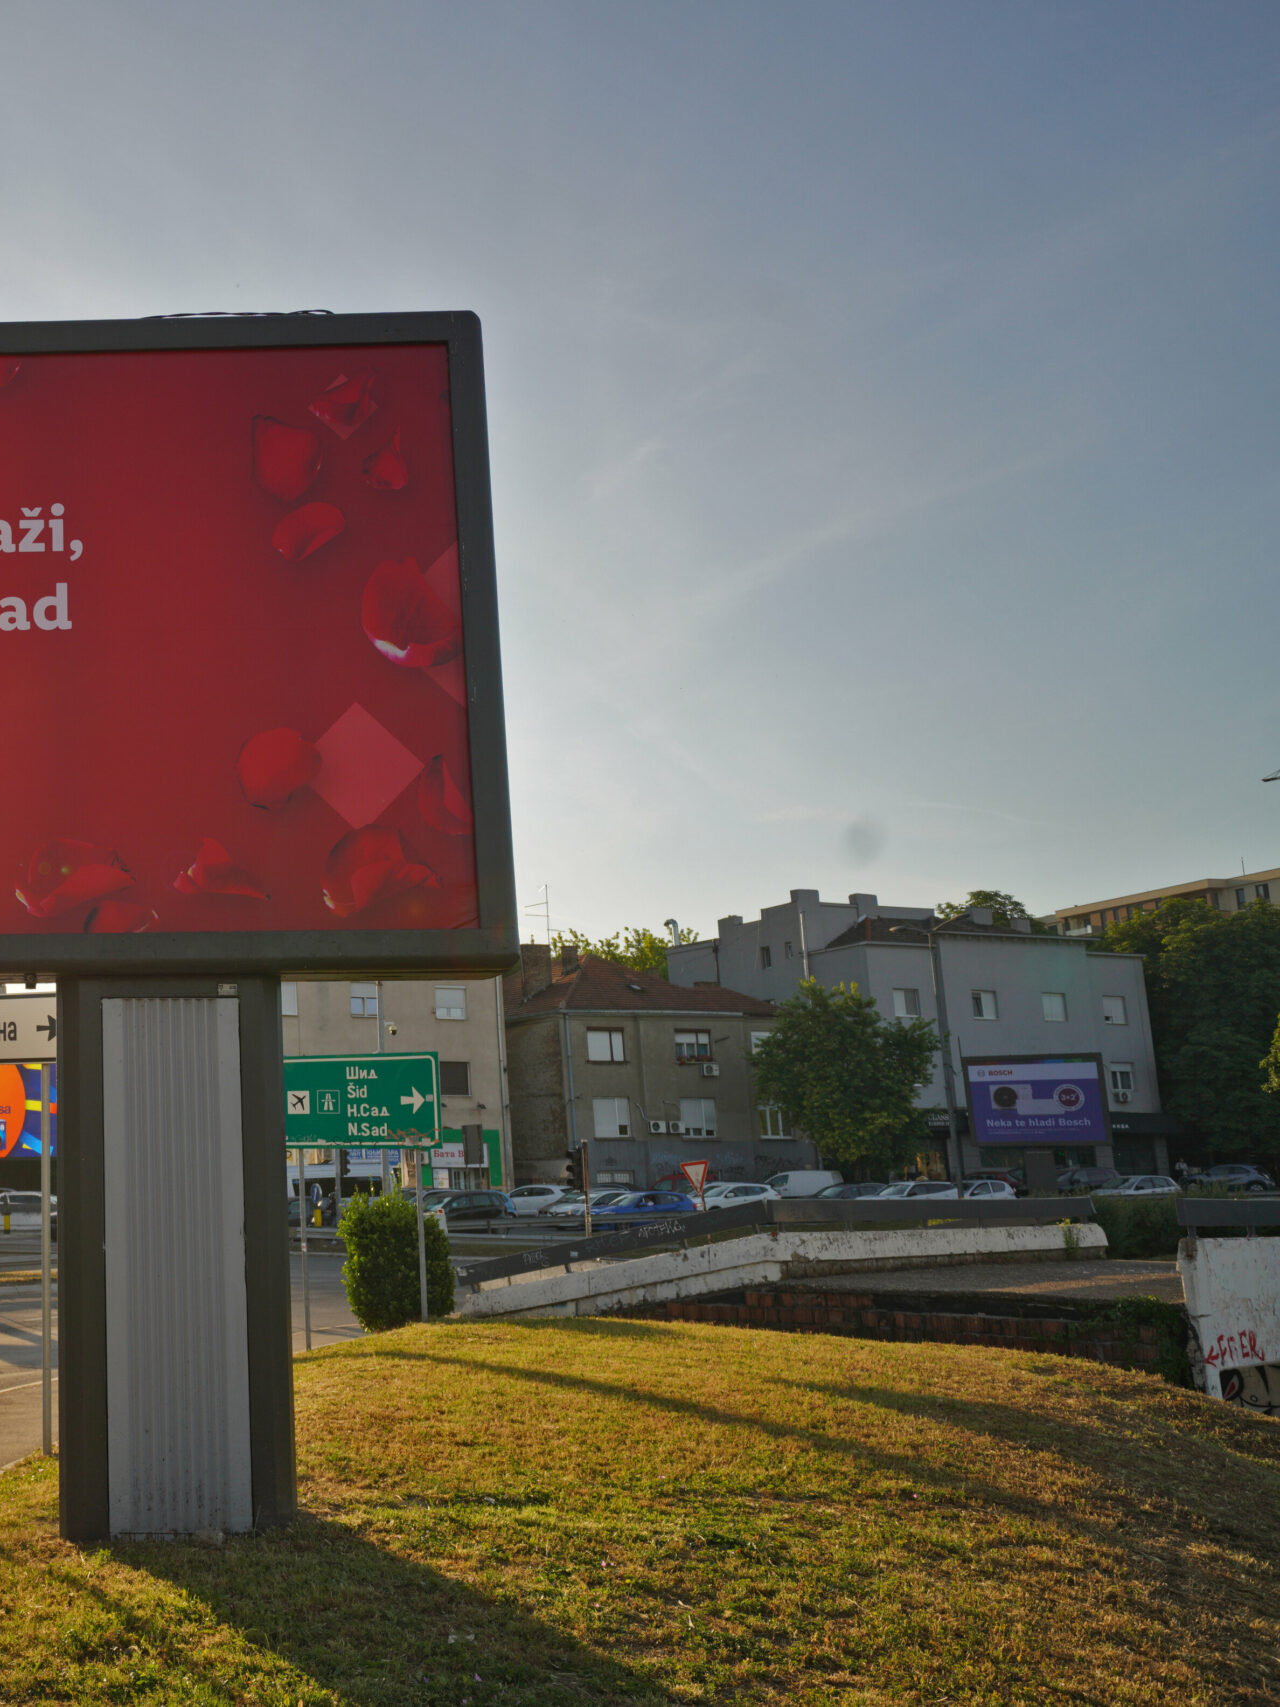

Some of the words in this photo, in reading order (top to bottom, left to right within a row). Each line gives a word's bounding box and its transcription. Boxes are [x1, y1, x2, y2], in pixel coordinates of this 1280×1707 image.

[345, 1066, 378, 1080] Шид
[347, 1082, 368, 1098] Šid
[347, 1104, 390, 1117] Н.Сад
[347, 1122, 388, 1136] N.Sad
[985, 1118, 1012, 1128] Neka
[1015, 1119, 1026, 1127] te
[1028, 1117, 1055, 1127] hladi
[1058, 1117, 1091, 1127] Bosch
[433, 1149, 456, 1158] Бата
